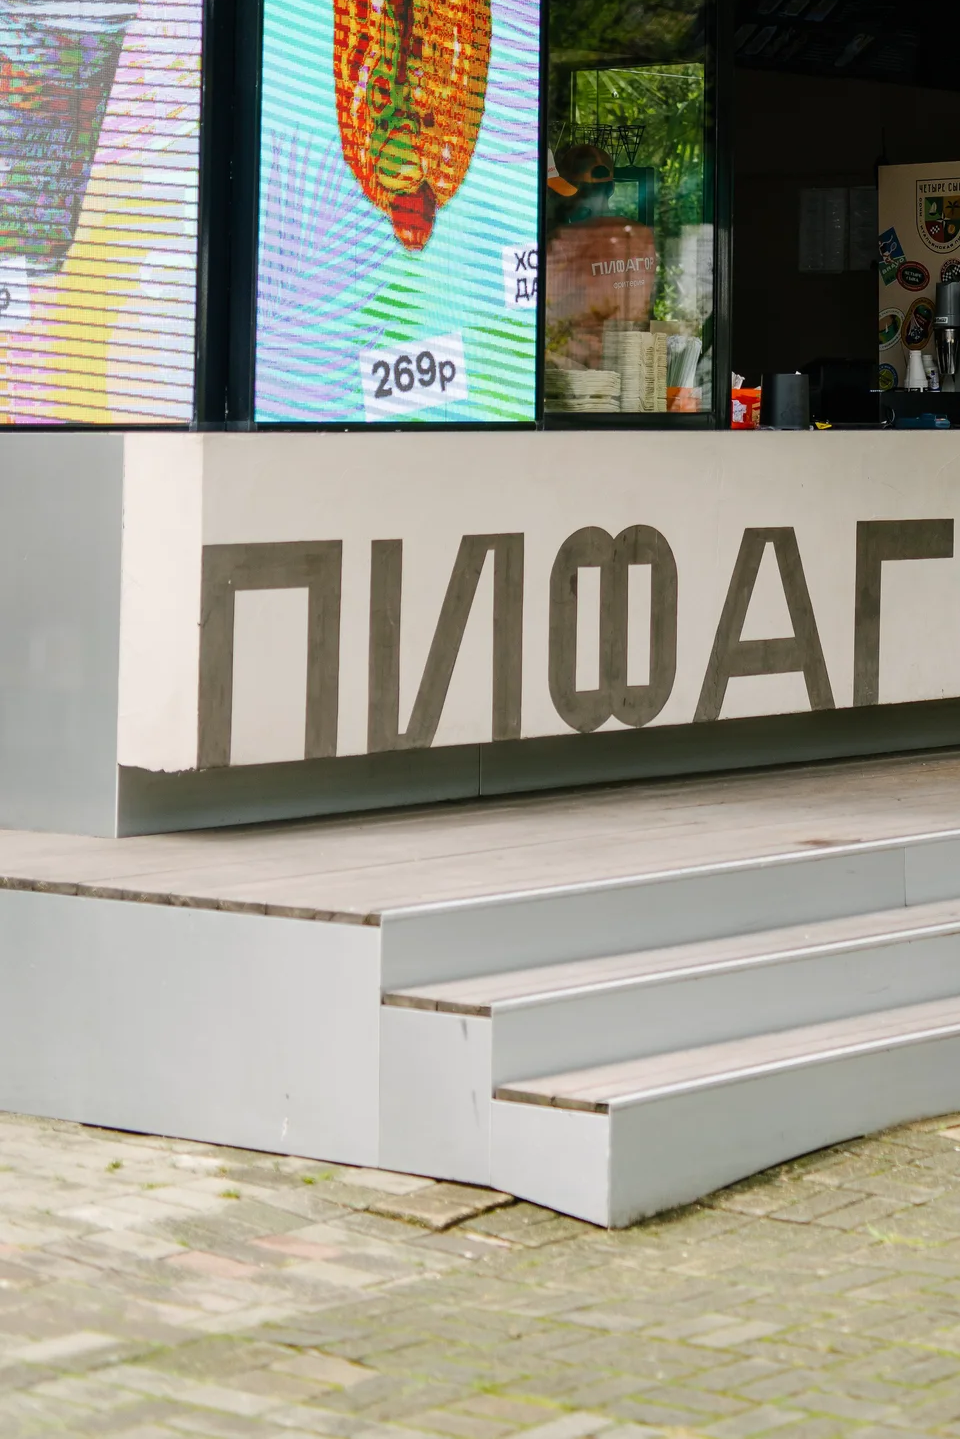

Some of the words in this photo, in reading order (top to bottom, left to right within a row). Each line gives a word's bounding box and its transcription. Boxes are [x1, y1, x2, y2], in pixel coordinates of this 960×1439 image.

[919, 183, 945, 193] ЧЕТЫРЕ
[591, 257, 654, 276] ПИФАГОР
[371, 350, 457, 399] 269р
